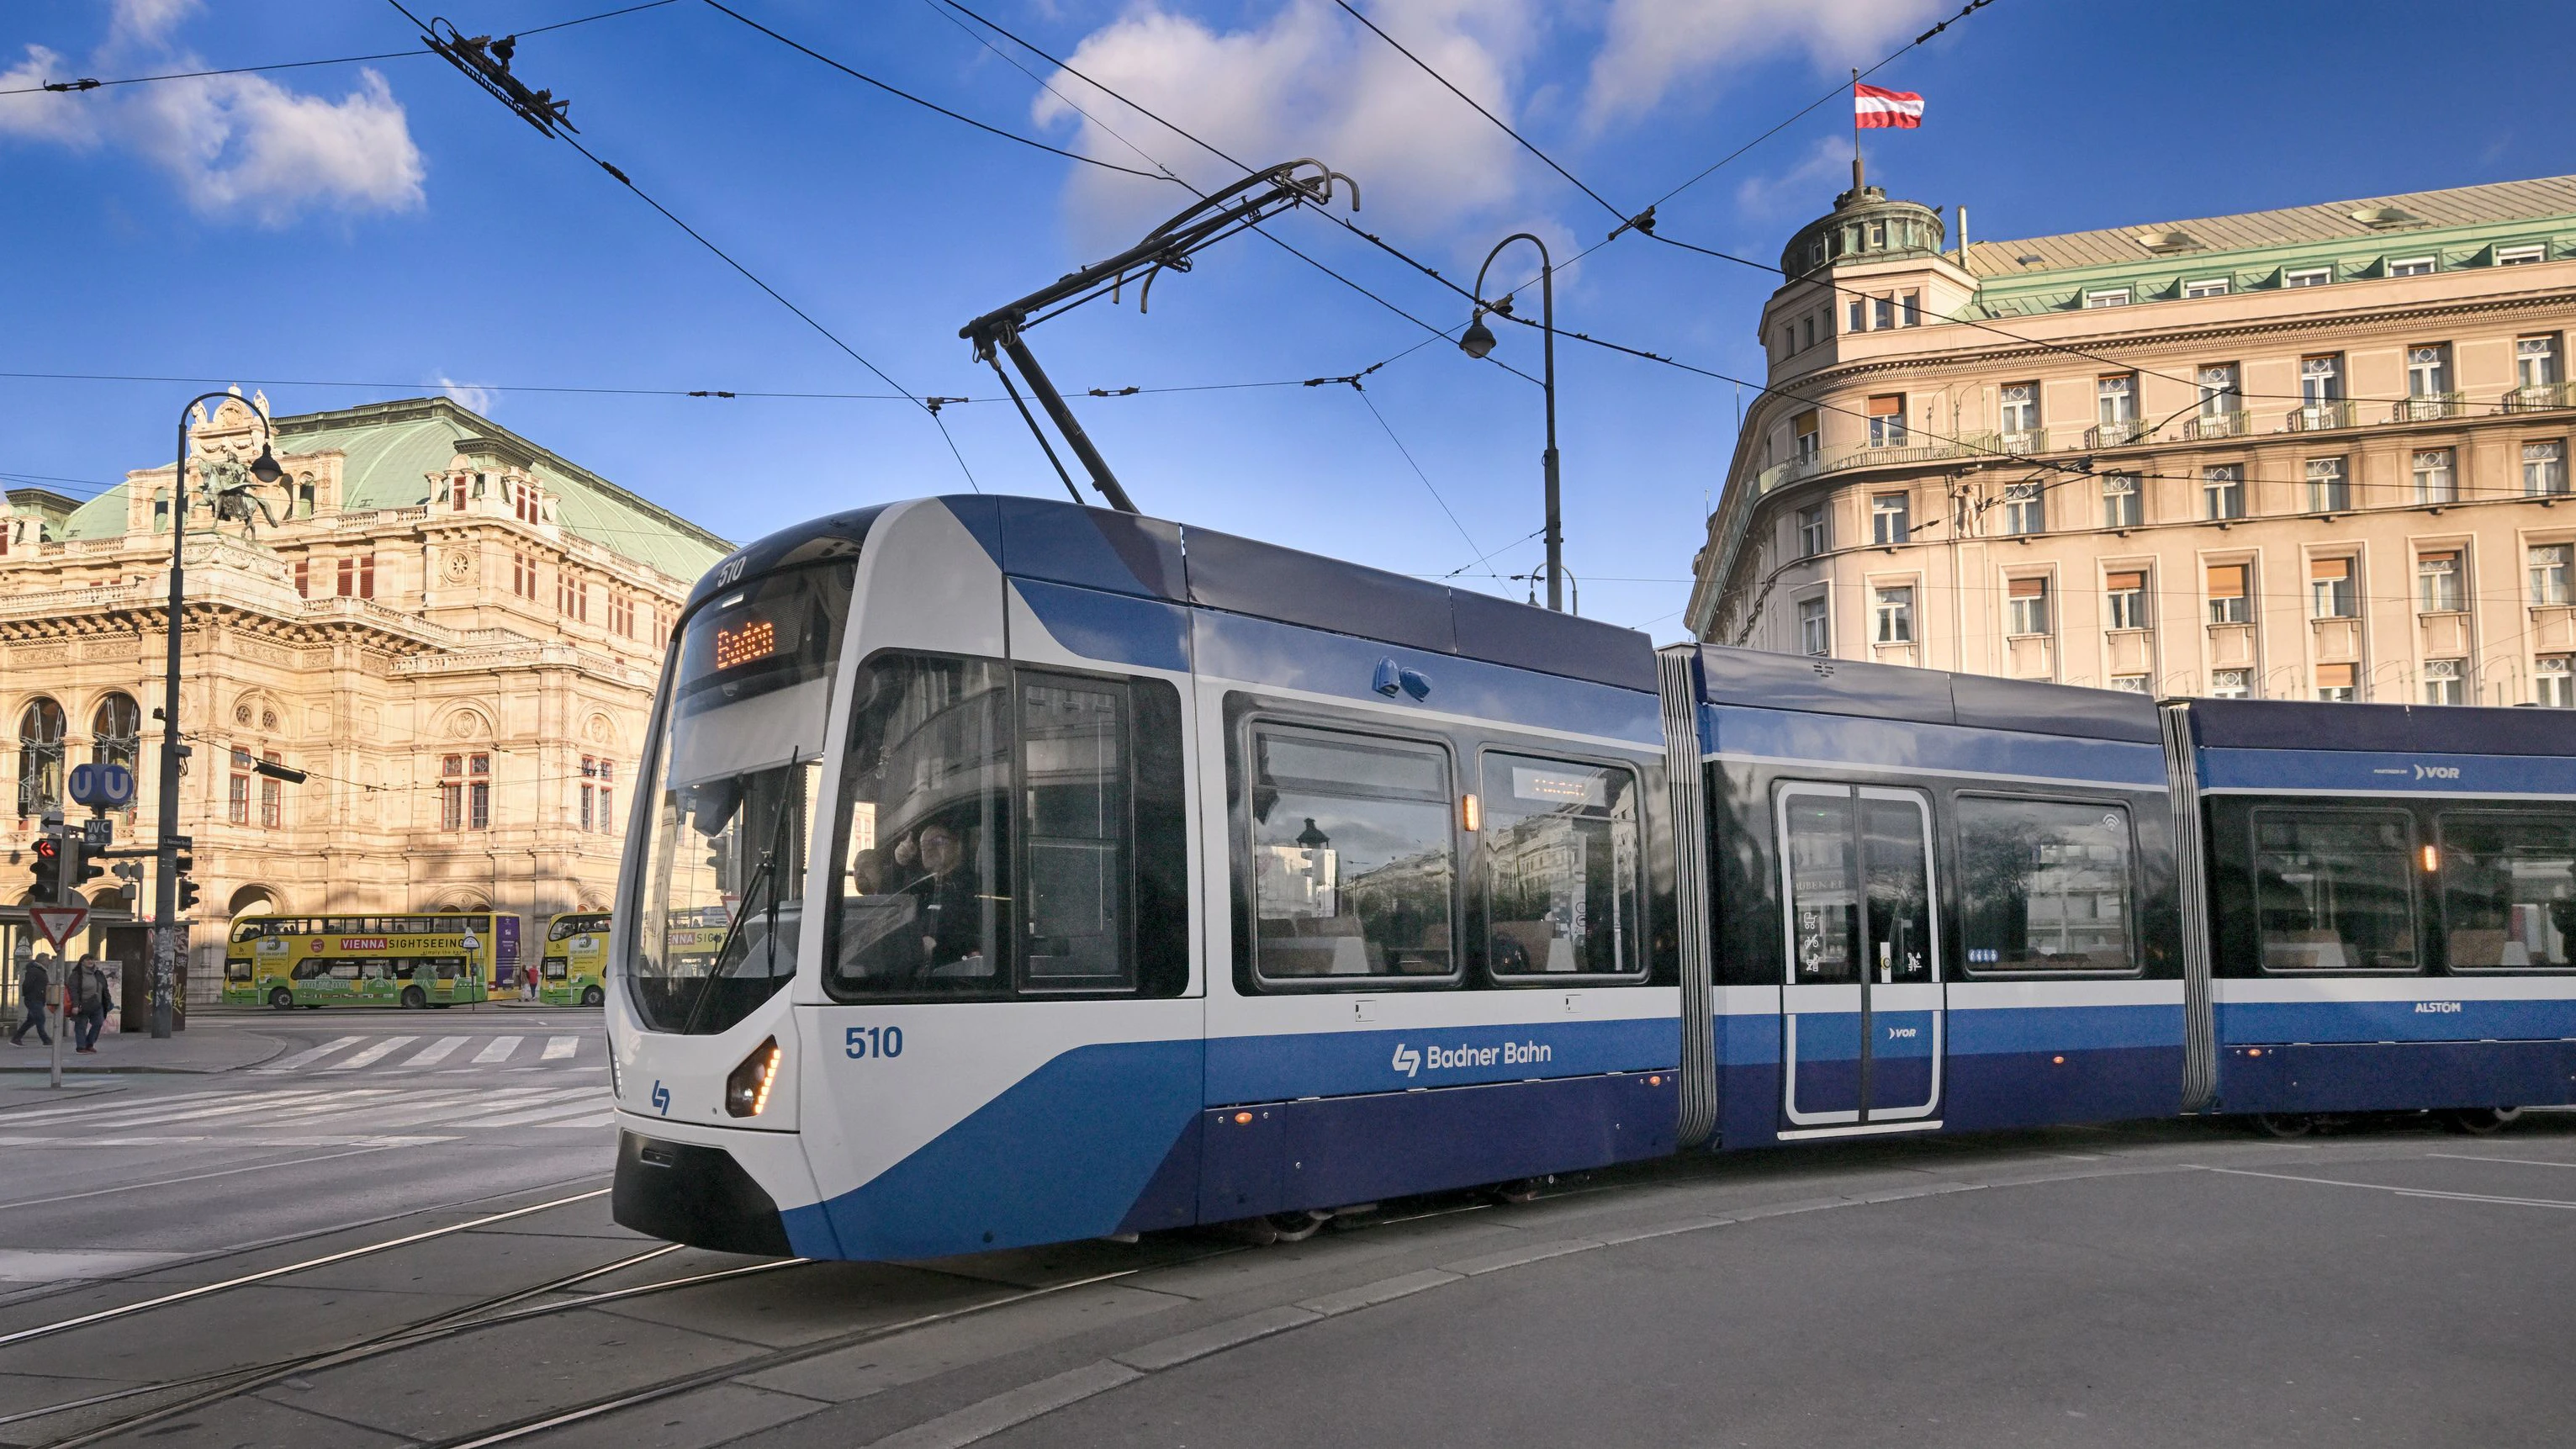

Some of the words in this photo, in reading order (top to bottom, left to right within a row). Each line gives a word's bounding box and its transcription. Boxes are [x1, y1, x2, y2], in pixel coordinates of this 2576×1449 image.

[717, 556, 747, 588] 510
[717, 621, 773, 669] Baden
[72, 771, 92, 799] U
[104, 771, 129, 799] U
[2424, 766, 2460, 779] VOR
[87, 822, 110, 833] WC
[342, 939, 385, 949] VIENNA
[389, 939, 463, 949] SIGHTSEEING
[2415, 1002, 2461, 1013] ALSTOM
[846, 1026, 903, 1059] 510
[1895, 1028, 1917, 1038] VOR
[1427, 1043, 1500, 1069] Badner
[1504, 1039, 1552, 1065] Bahn
